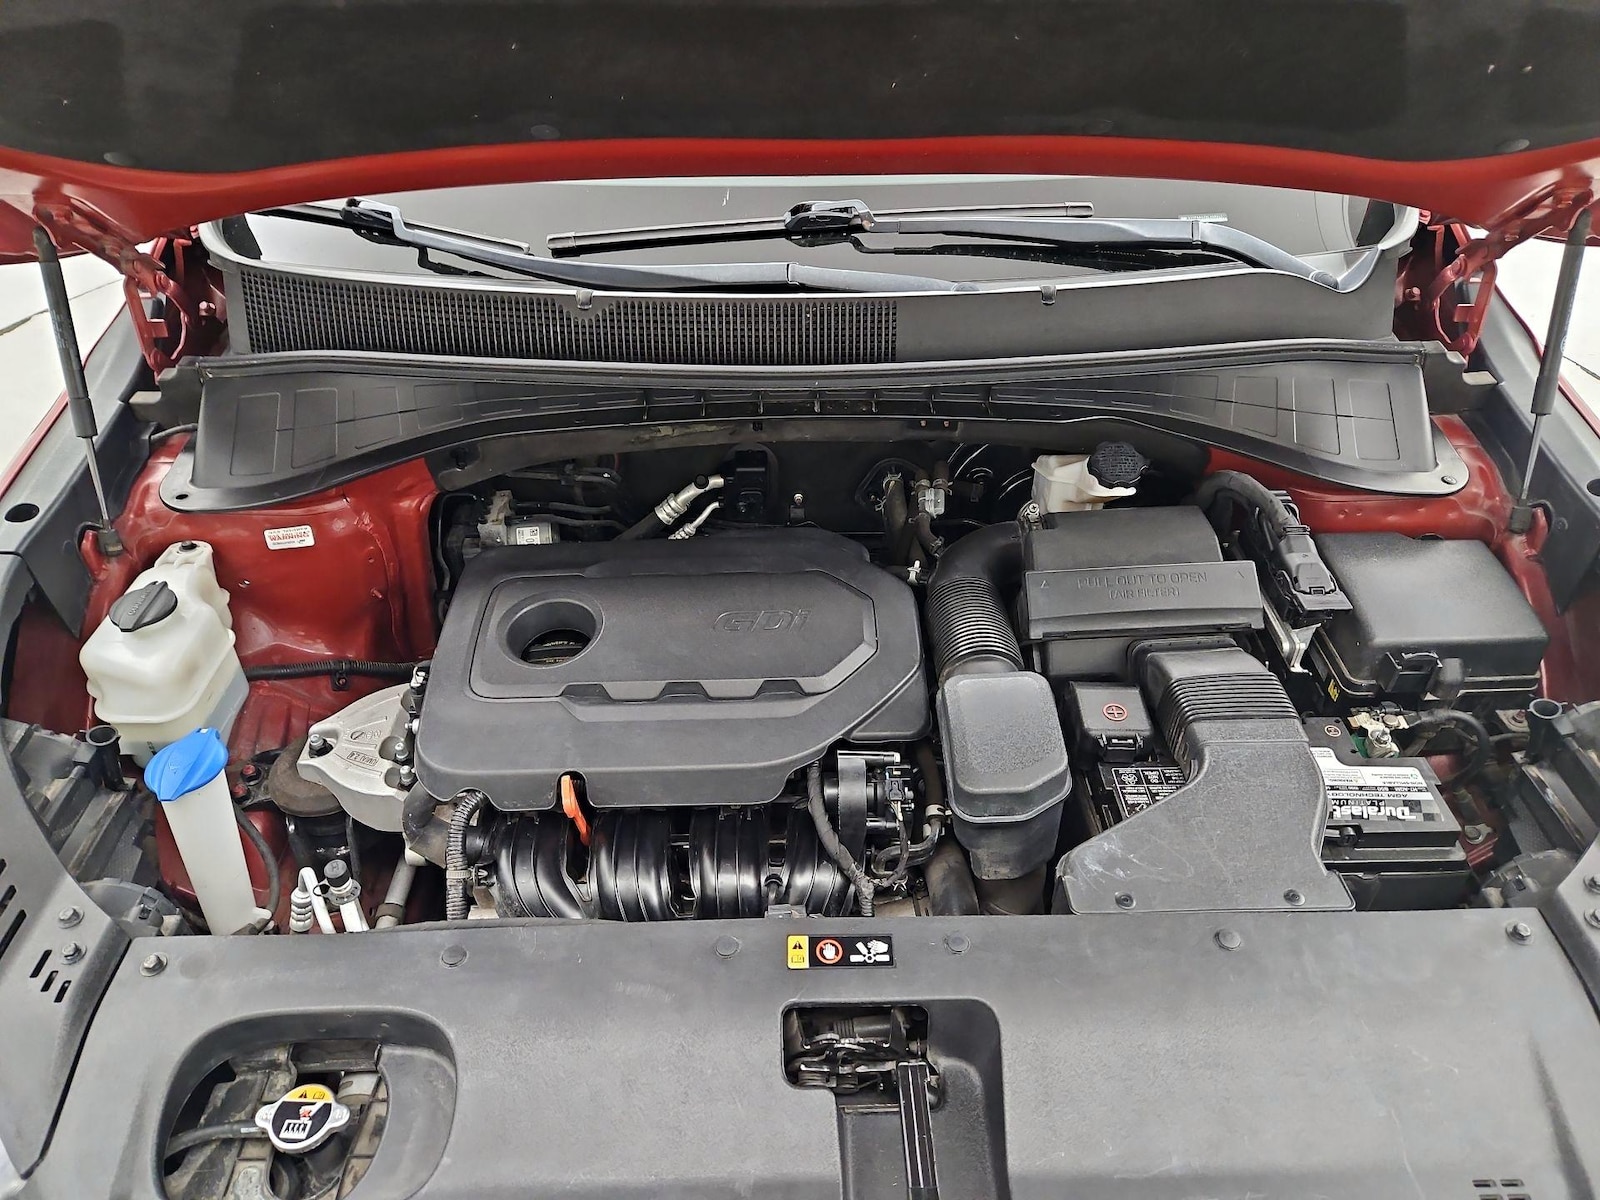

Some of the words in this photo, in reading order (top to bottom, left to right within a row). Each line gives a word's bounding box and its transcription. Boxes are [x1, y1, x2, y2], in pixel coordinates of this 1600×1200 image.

[1077, 576, 1113, 589] PULL
[1116, 574, 1144, 586] OUT
[1149, 573, 1167, 585] TO
[1169, 571, 1208, 584] OPEN
[1333, 806, 1416, 820] Duralast
